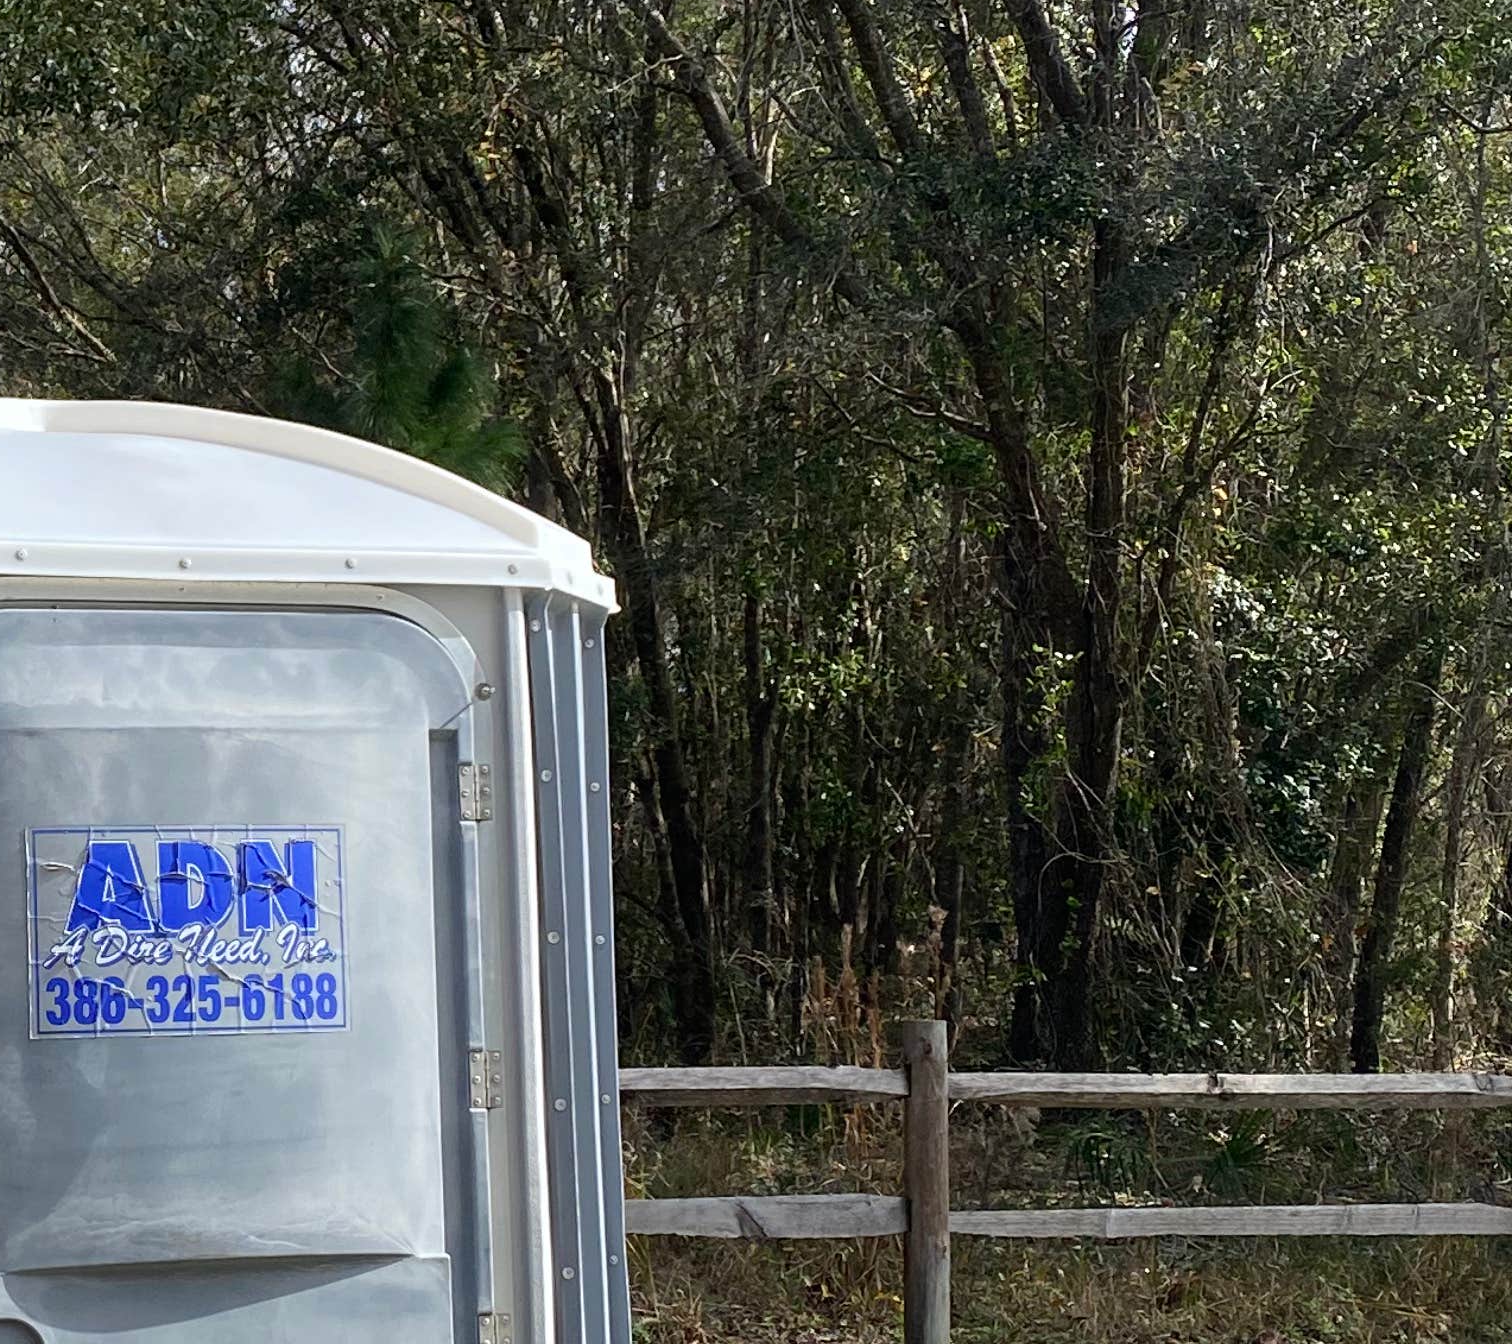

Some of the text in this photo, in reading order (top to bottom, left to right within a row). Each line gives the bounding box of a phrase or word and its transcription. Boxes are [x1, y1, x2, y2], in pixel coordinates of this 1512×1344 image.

[62, 840, 318, 936] ADN
[43, 926, 85, 969] A
[91, 926, 172, 966] Dire
[276, 922, 336, 966] Inc.
[45, 973, 337, 1026] 386-325-6188
